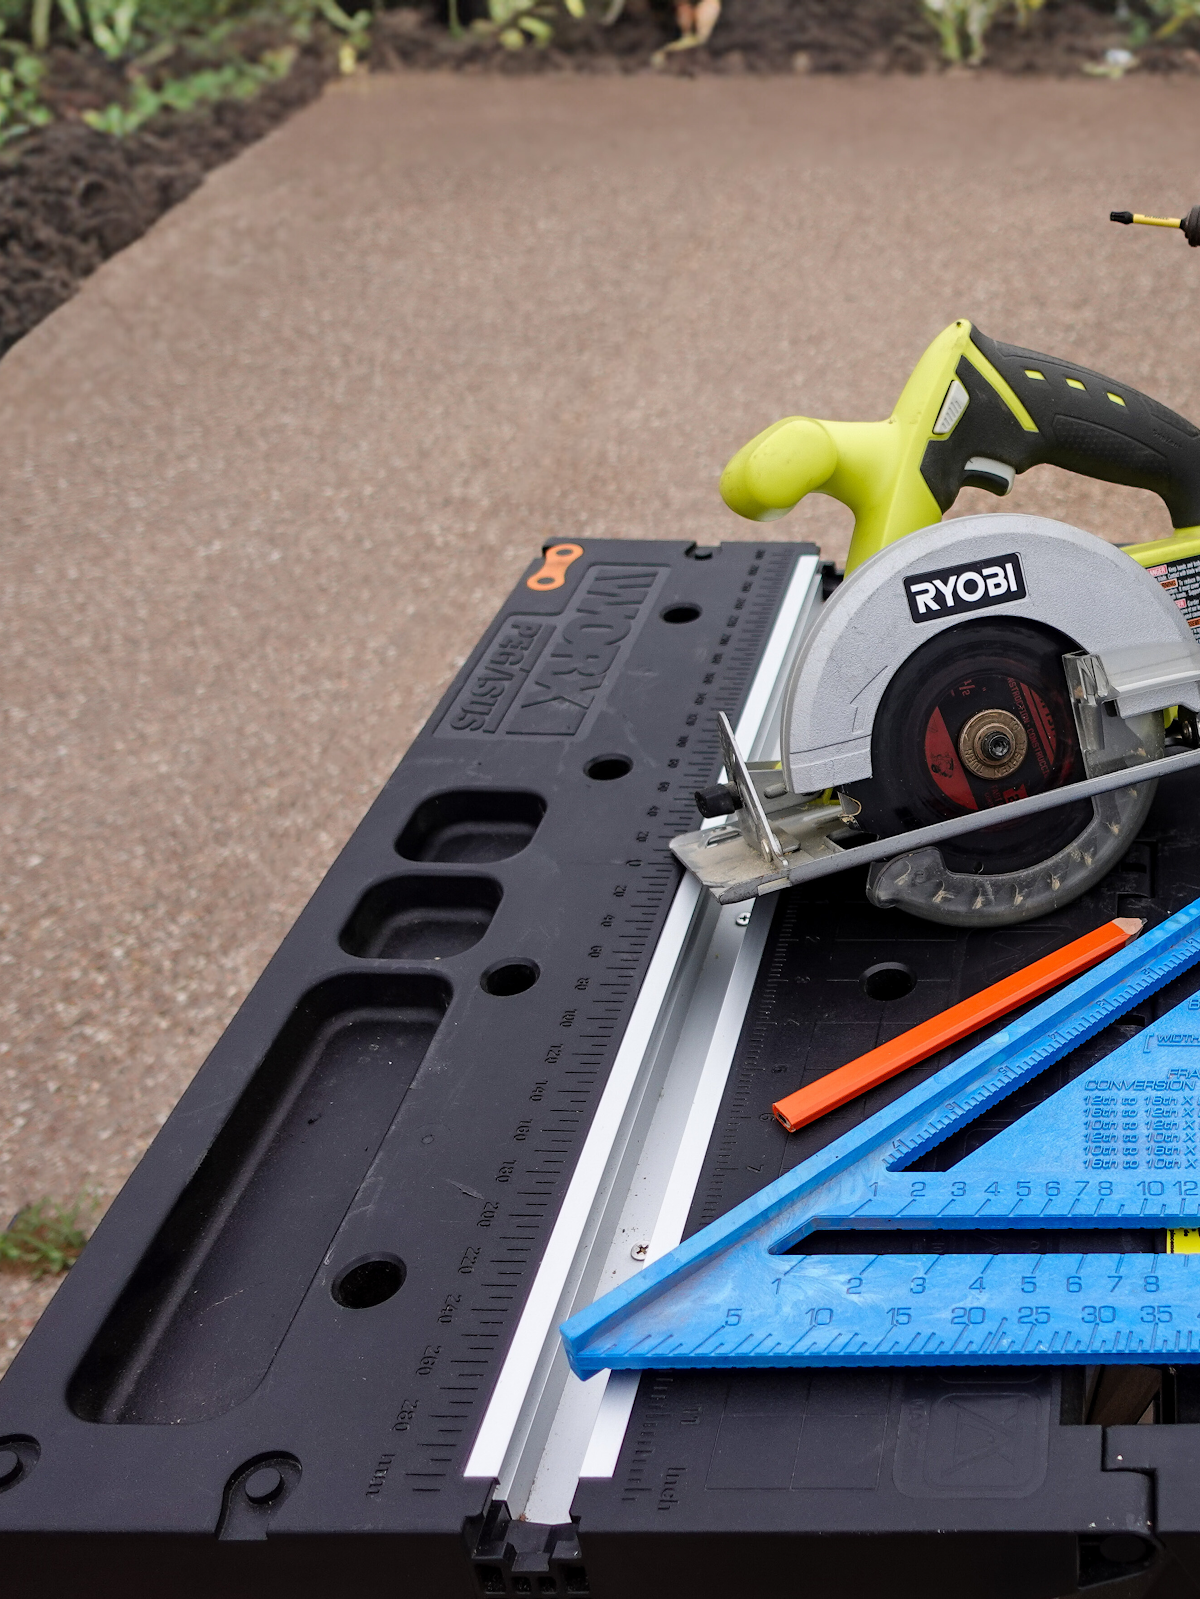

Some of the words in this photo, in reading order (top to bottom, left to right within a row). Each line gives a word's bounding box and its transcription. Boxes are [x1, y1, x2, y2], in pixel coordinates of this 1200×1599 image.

[910, 562, 1018, 614] RYOBI
[520, 572, 658, 709] WORX
[449, 623, 543, 733] PEGASUS
[1084, 1080, 1196, 1091] CONVERSION
[1122, 1096, 1137, 1106] to
[1181, 1095, 1194, 1106] X
[1122, 1108, 1138, 1118] to
[1181, 1108, 1195, 1118] X
[1122, 1121, 1138, 1131] to
[1182, 1120, 1196, 1131] X
[869, 1181, 879, 1197] 1
[910, 1181, 926, 1197] 2
[951, 1181, 967, 1197] 3
[984, 1181, 1000, 1197] 4
[1016, 1181, 1031, 1197] 5
[1045, 1181, 1061, 1196] 6
[1074, 1181, 1090, 1196] 7
[1098, 1181, 1113, 1196] 8
[1137, 1181, 1165, 1196] 10
[1173, 1181, 1199, 1196] 12
[477, 1202, 499, 1228] 200
[458, 1247, 481, 1274] 220
[771, 1277, 782, 1294] 1
[846, 1277, 863, 1295] 2
[910, 1277, 926, 1294] 3
[968, 1276, 986, 1293] 4
[1021, 1276, 1037, 1293] 5
[1066, 1275, 1082, 1293] 6
[1107, 1275, 1123, 1293] 7
[1143, 1275, 1160, 1293] 8
[724, 1308, 743, 1327] 5
[805, 1307, 834, 1326] 10
[886, 1307, 912, 1325] 15
[951, 1306, 986, 1325] 20
[1017, 1306, 1051, 1325] 25
[1081, 1305, 1117, 1323] 30
[1140, 1305, 1173, 1323] 35
